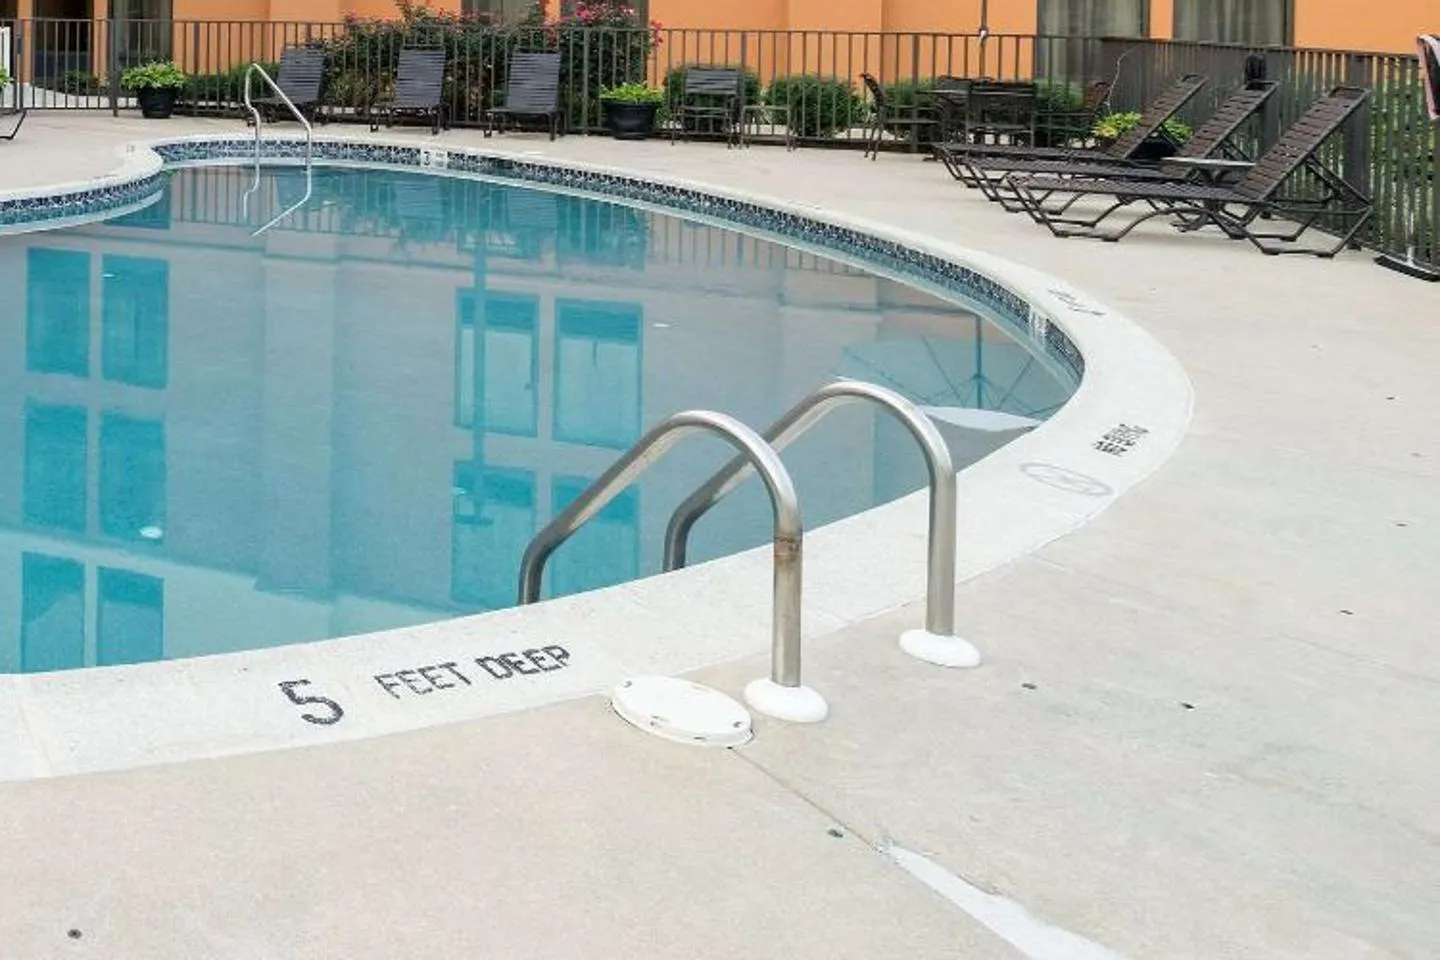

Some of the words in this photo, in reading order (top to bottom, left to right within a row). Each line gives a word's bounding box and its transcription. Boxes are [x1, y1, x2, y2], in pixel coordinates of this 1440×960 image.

[277, 678, 344, 725] 5
[374, 661, 472, 699] FEET
[474, 644, 571, 680] DEEP
